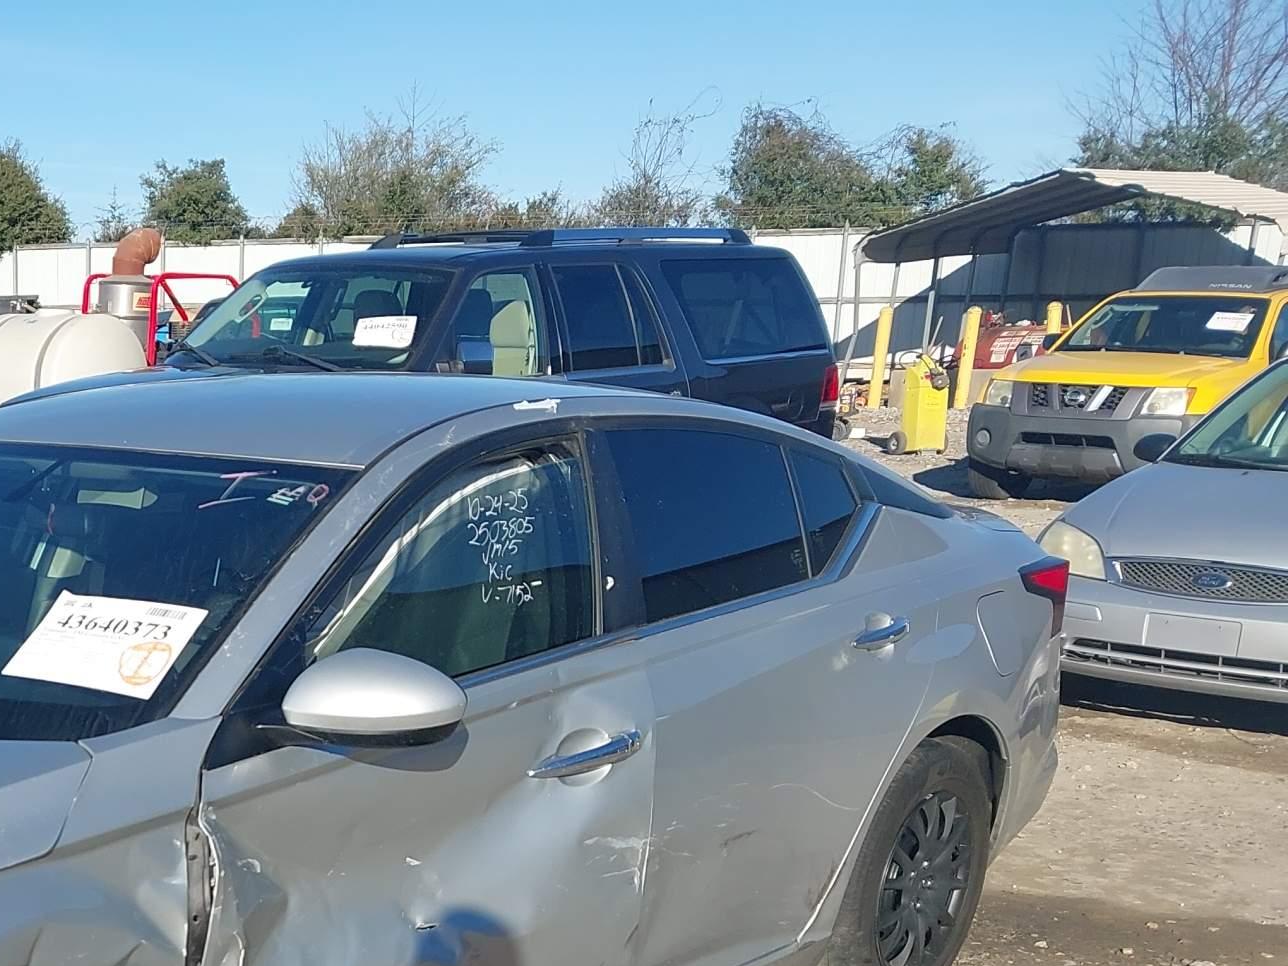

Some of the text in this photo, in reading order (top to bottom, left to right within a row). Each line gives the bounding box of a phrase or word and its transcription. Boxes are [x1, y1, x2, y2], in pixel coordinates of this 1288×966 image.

[467, 488, 528, 521] 10-24-25
[467, 516, 536, 546] 2503805
[57, 613, 172, 639] 43640373
